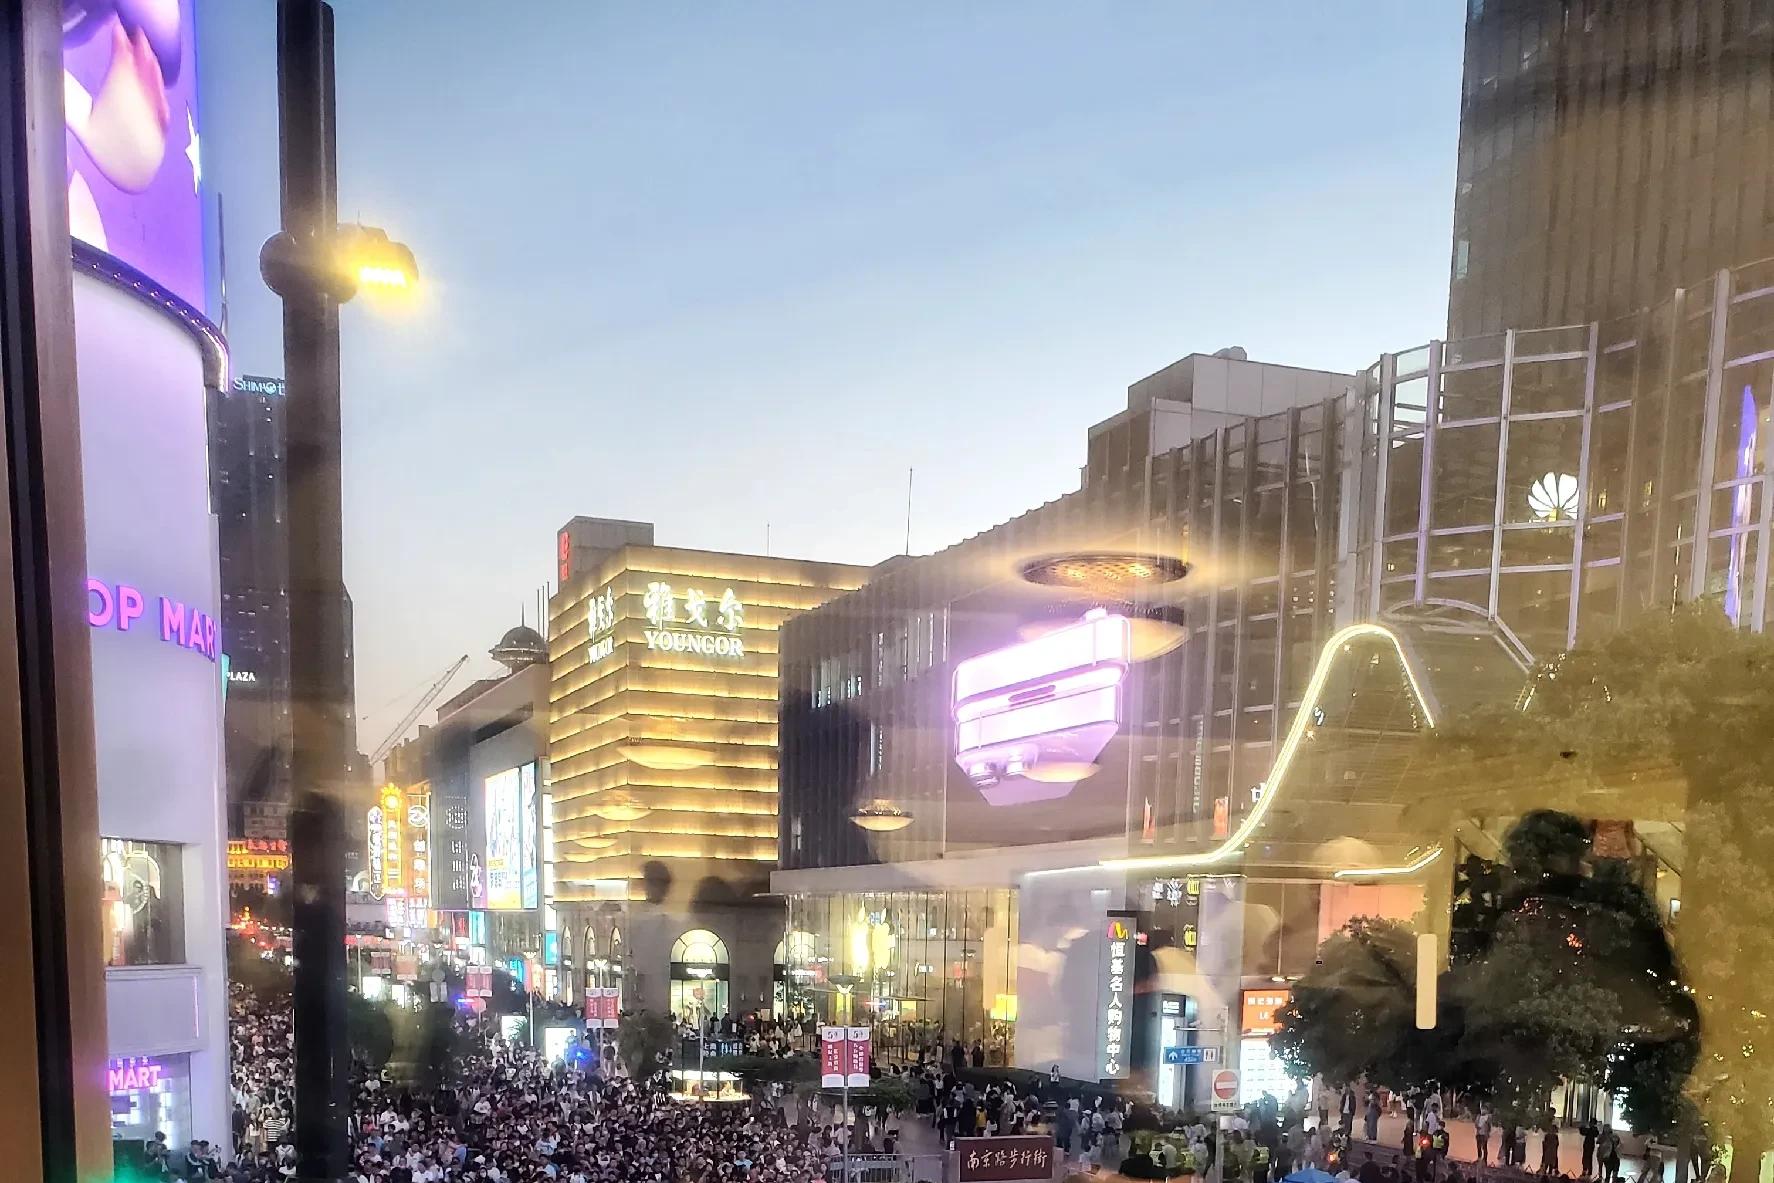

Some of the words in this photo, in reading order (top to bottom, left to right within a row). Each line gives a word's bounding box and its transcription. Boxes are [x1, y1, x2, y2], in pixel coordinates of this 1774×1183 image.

[160, 596, 217, 663] MAR
[643, 630, 745, 657] YOUNGOR
[1105, 941, 1126, 1076] 恒基名人购物中心
[108, 1065, 162, 1091] MART
